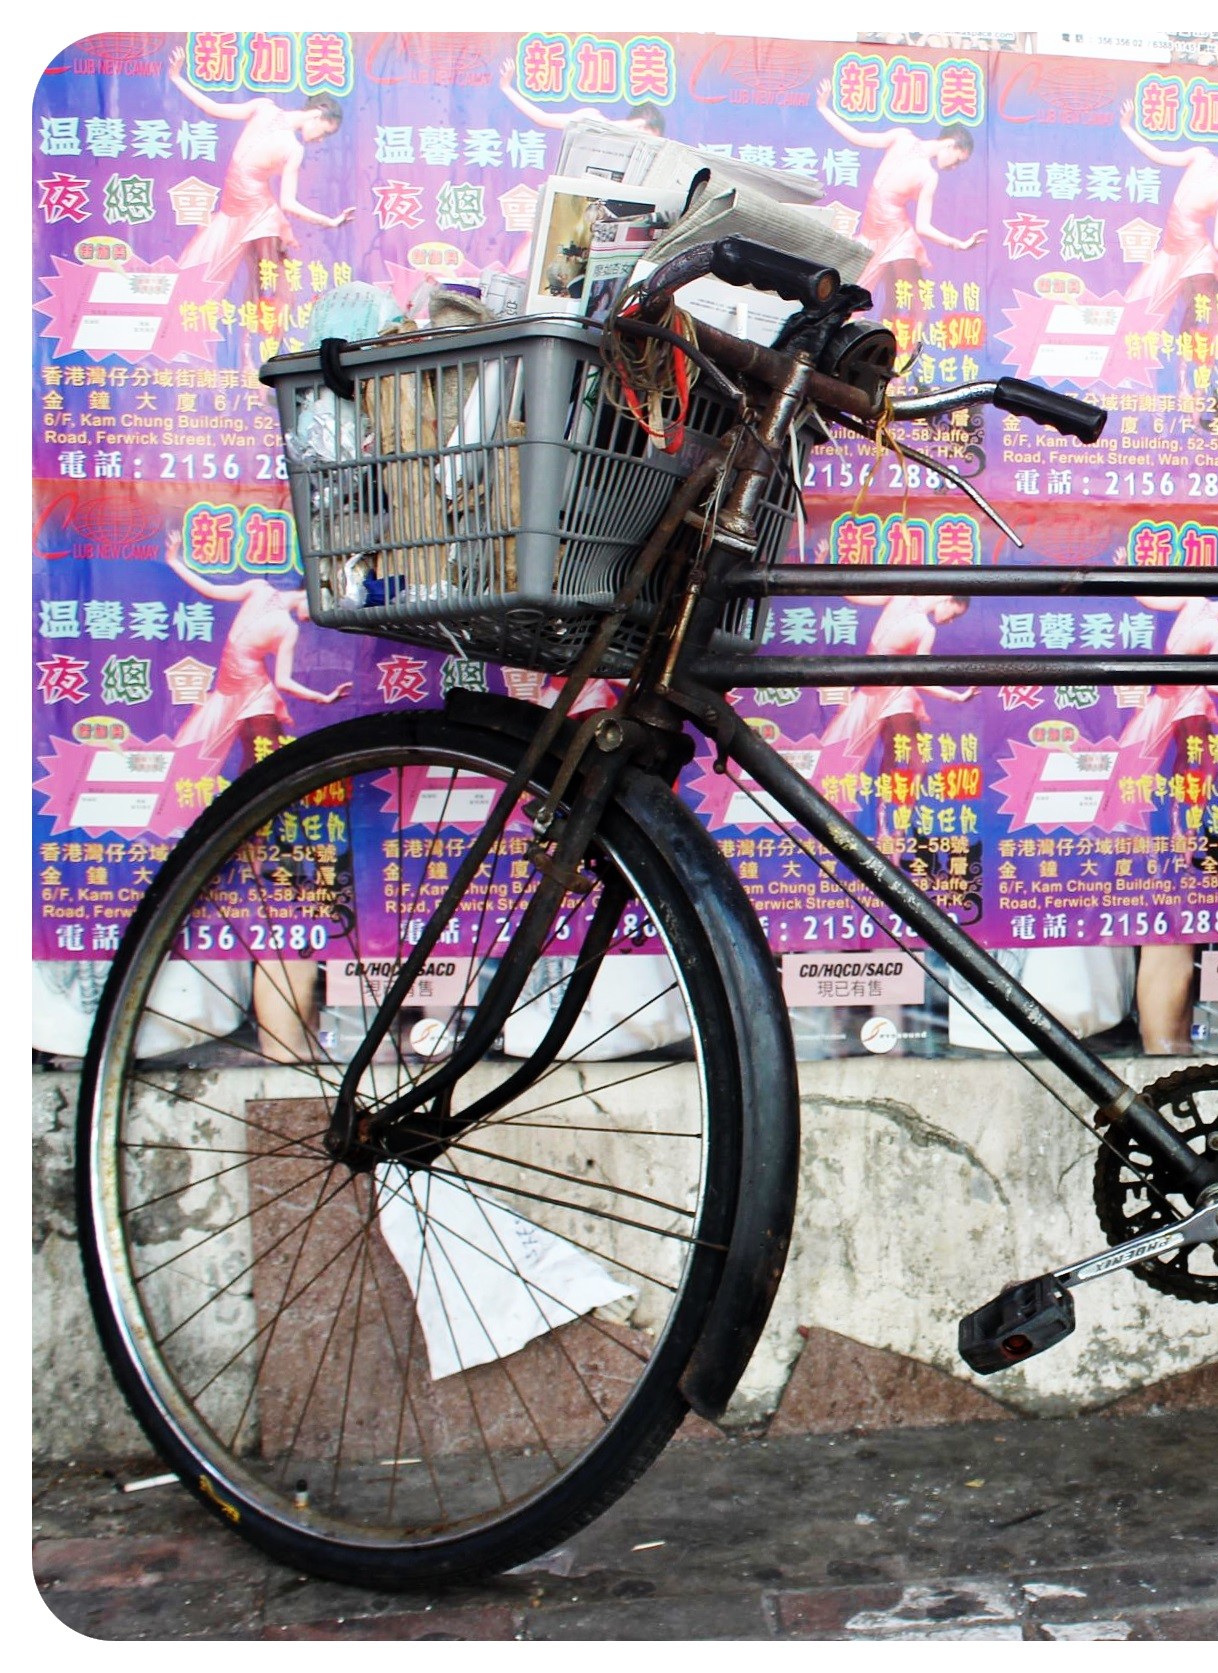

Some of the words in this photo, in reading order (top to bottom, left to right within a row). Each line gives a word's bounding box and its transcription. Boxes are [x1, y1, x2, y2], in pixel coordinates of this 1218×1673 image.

[190, 32, 350, 91] 新加美
[519, 36, 673, 101] 新加美
[837, 56, 980, 122] 新加美
[37, 172, 221, 226] 夜總會
[1003, 212, 1163, 263] 夜總會
[80, 414, 116, 427] Kam
[120, 414, 174, 432] Chung
[177, 415, 248, 432] Building,
[932, 427, 969, 442] Jaffe
[44, 430, 92, 445] Road,
[96, 430, 160, 446] Ferwick
[162, 431, 217, 447] Street,
[221, 432, 256, 447] Wan
[1036, 435, 1068, 447] Kam
[1121, 437, 1182, 451] Building,
[159, 452, 241, 479] 2156
[1003, 451, 1046, 464] Road,
[1050, 452, 1106, 465] Ferwick
[1108, 453, 1154, 466] Street,
[1158, 454, 1189, 466] Wan
[804, 464, 875, 488] 2156
[1105, 471, 1175, 496] 2156
[188, 506, 300, 568] 新加
[834, 516, 978, 565] 新加美
[37, 653, 218, 706] 夜總會
[78, 888, 113, 901] Kam
[768, 880, 817, 896] Chung
[932, 878, 969, 892] Jaffe
[1031, 880, 1063, 893] Kam
[1067, 878, 1112, 896] Chung
[1116, 876, 1175, 893] Building,
[42, 905, 90, 920] Road,
[999, 896, 1041, 910] Road,
[1045, 895, 1099, 909] Ferwick
[1102, 894, 1148, 908] Street,
[1152, 893, 1182, 906] Wan
[183, 924, 235, 950] 156
[250, 925, 327, 950] 2880
[803, 915, 875, 940] 2156
[1100, 912, 1168, 938] 2156
[799, 962, 903, 978] CD/HQCD/SACD
[817, 980, 882, 999] 現已有售
